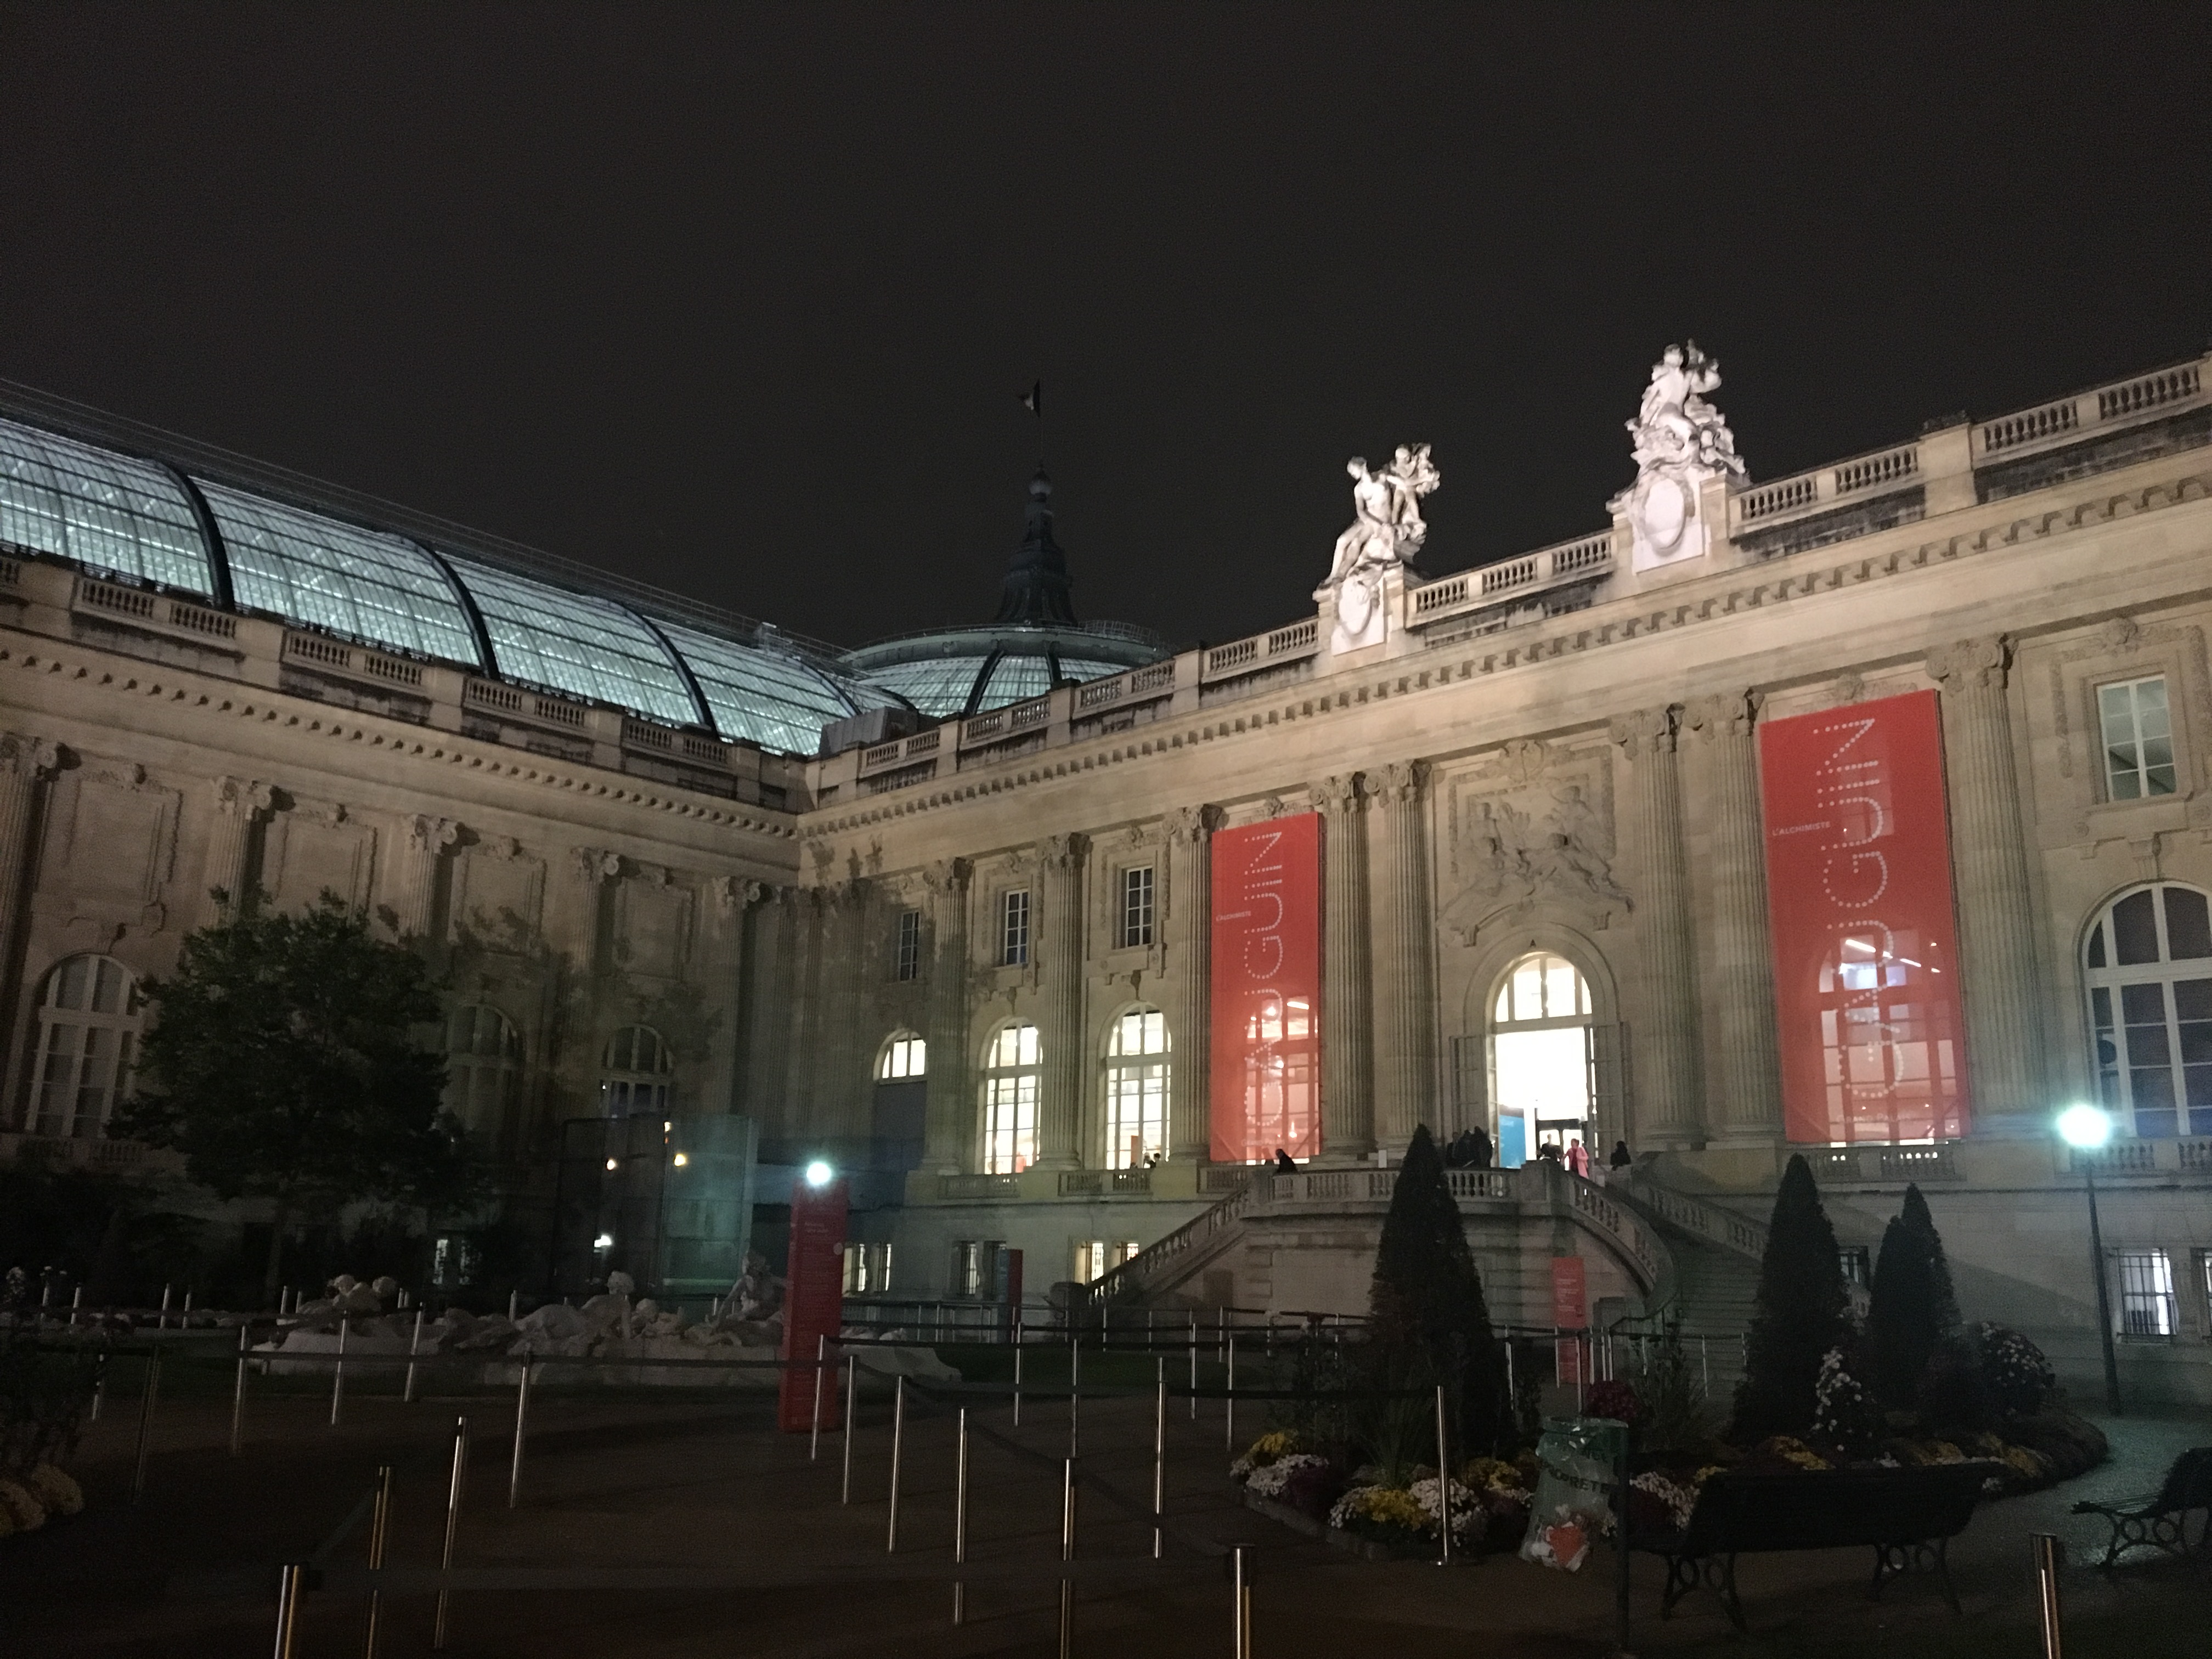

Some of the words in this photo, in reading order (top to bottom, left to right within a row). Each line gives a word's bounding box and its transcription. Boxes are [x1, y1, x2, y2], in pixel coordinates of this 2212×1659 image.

[1772, 821, 1831, 836] L'ALCHIMISTE
[1813, 718, 1904, 1098] GAUGUIN
[1244, 832, 1283, 1126] GAUGUIN
